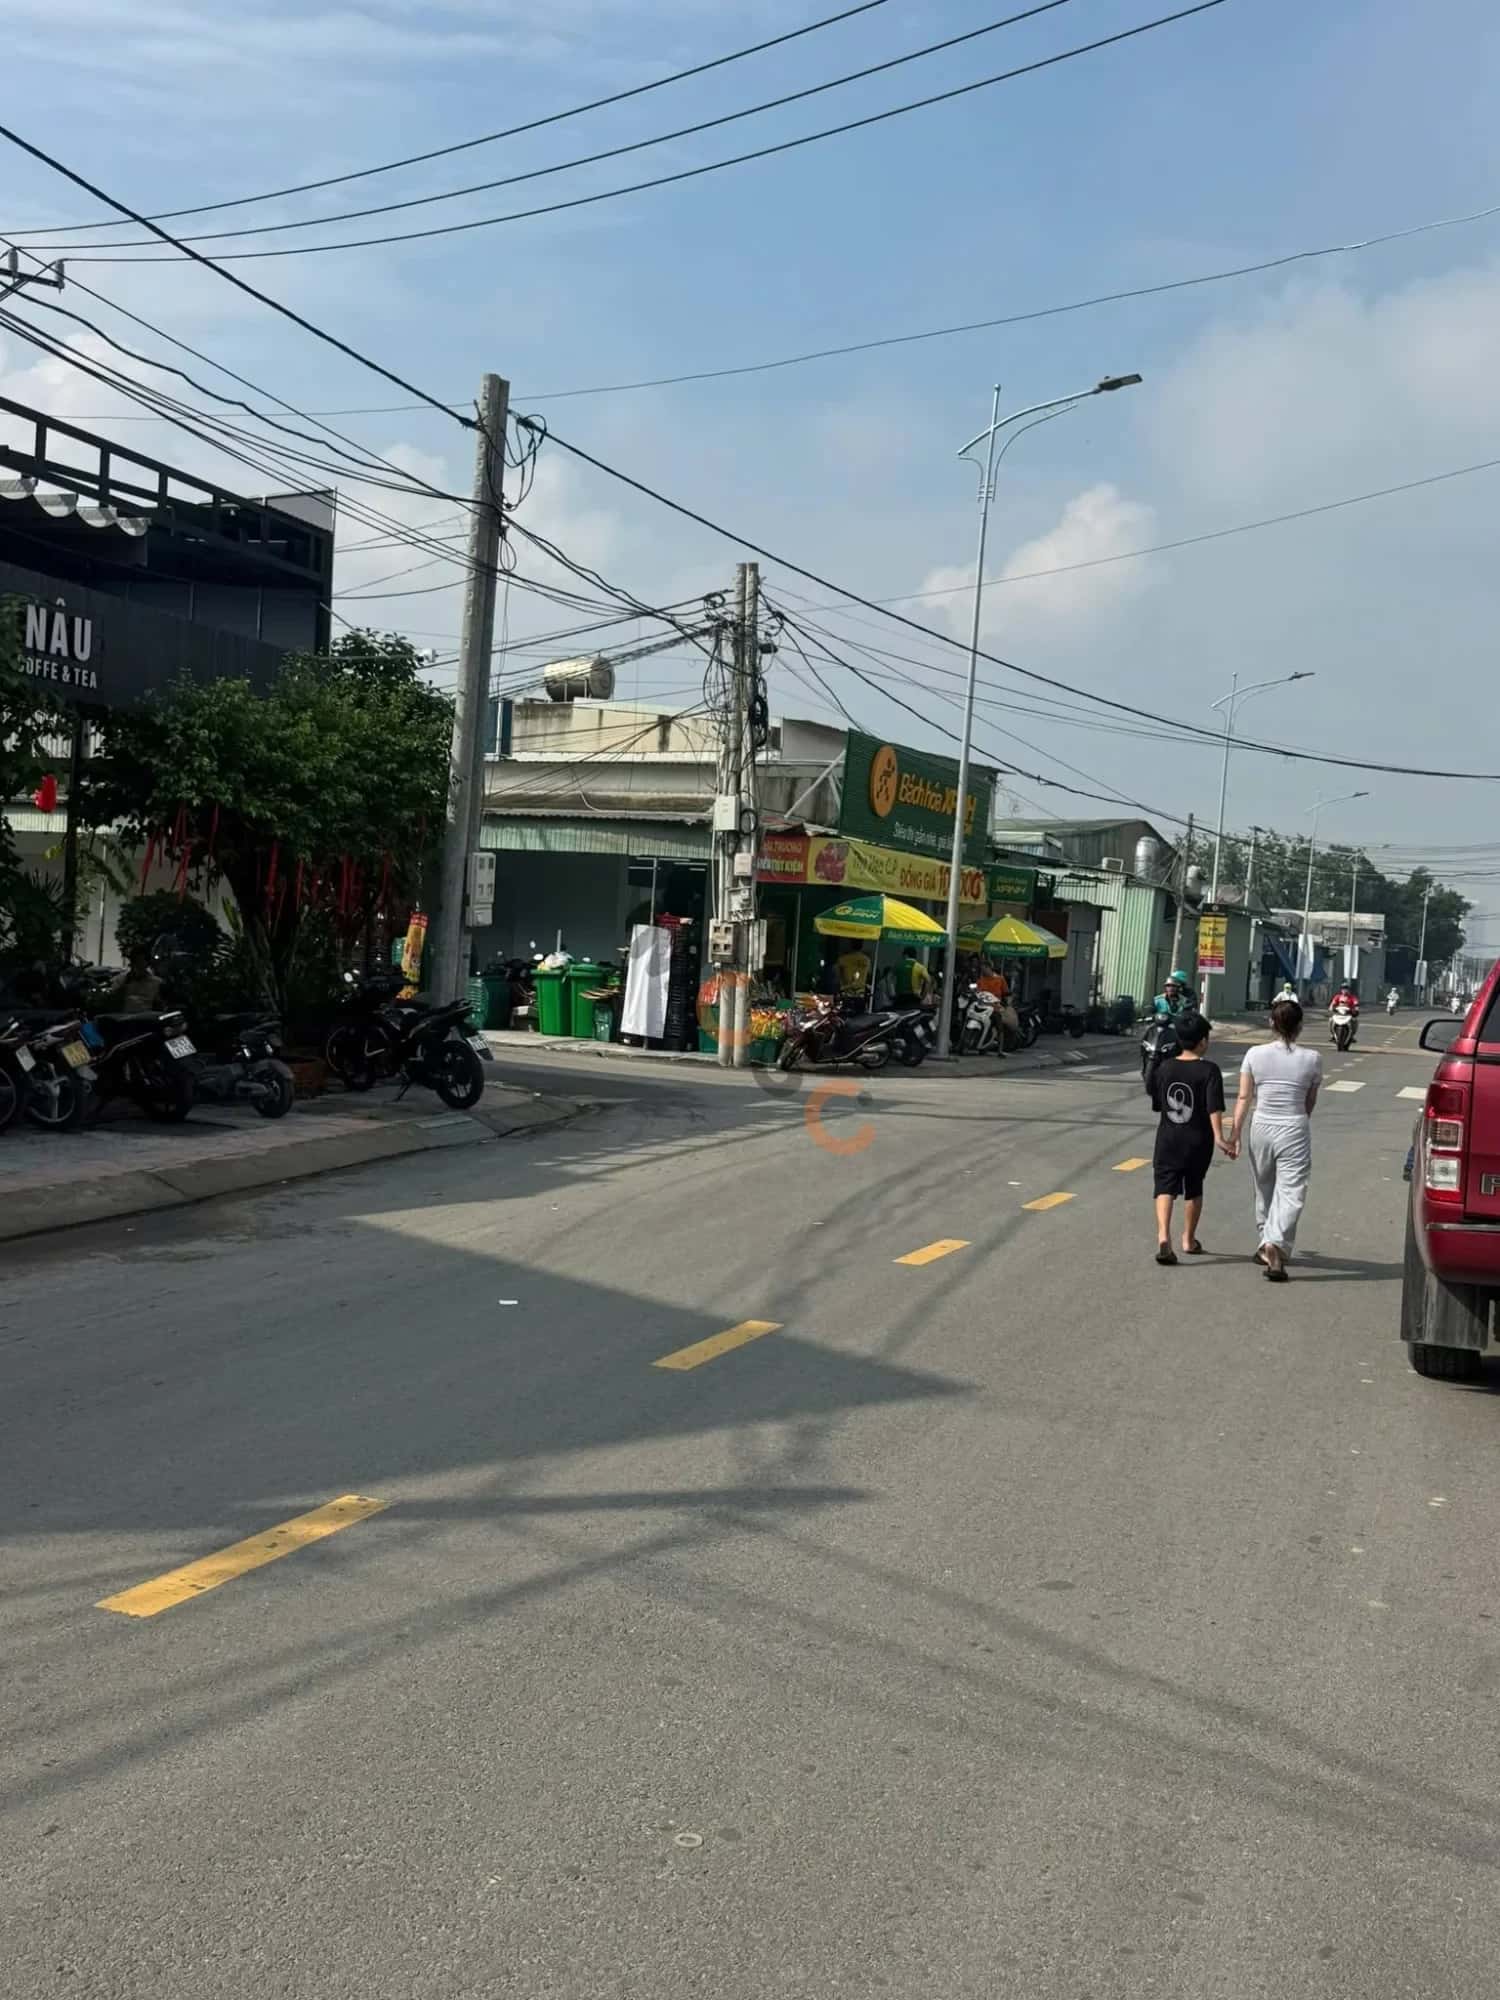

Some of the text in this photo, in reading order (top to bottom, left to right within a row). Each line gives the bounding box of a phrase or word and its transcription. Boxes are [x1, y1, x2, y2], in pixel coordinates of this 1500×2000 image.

[25, 597, 92, 661] NÂU
[62, 665, 71, 682] &
[73, 667, 97, 689] TEA
[1166, 1081, 1194, 1124] 9
